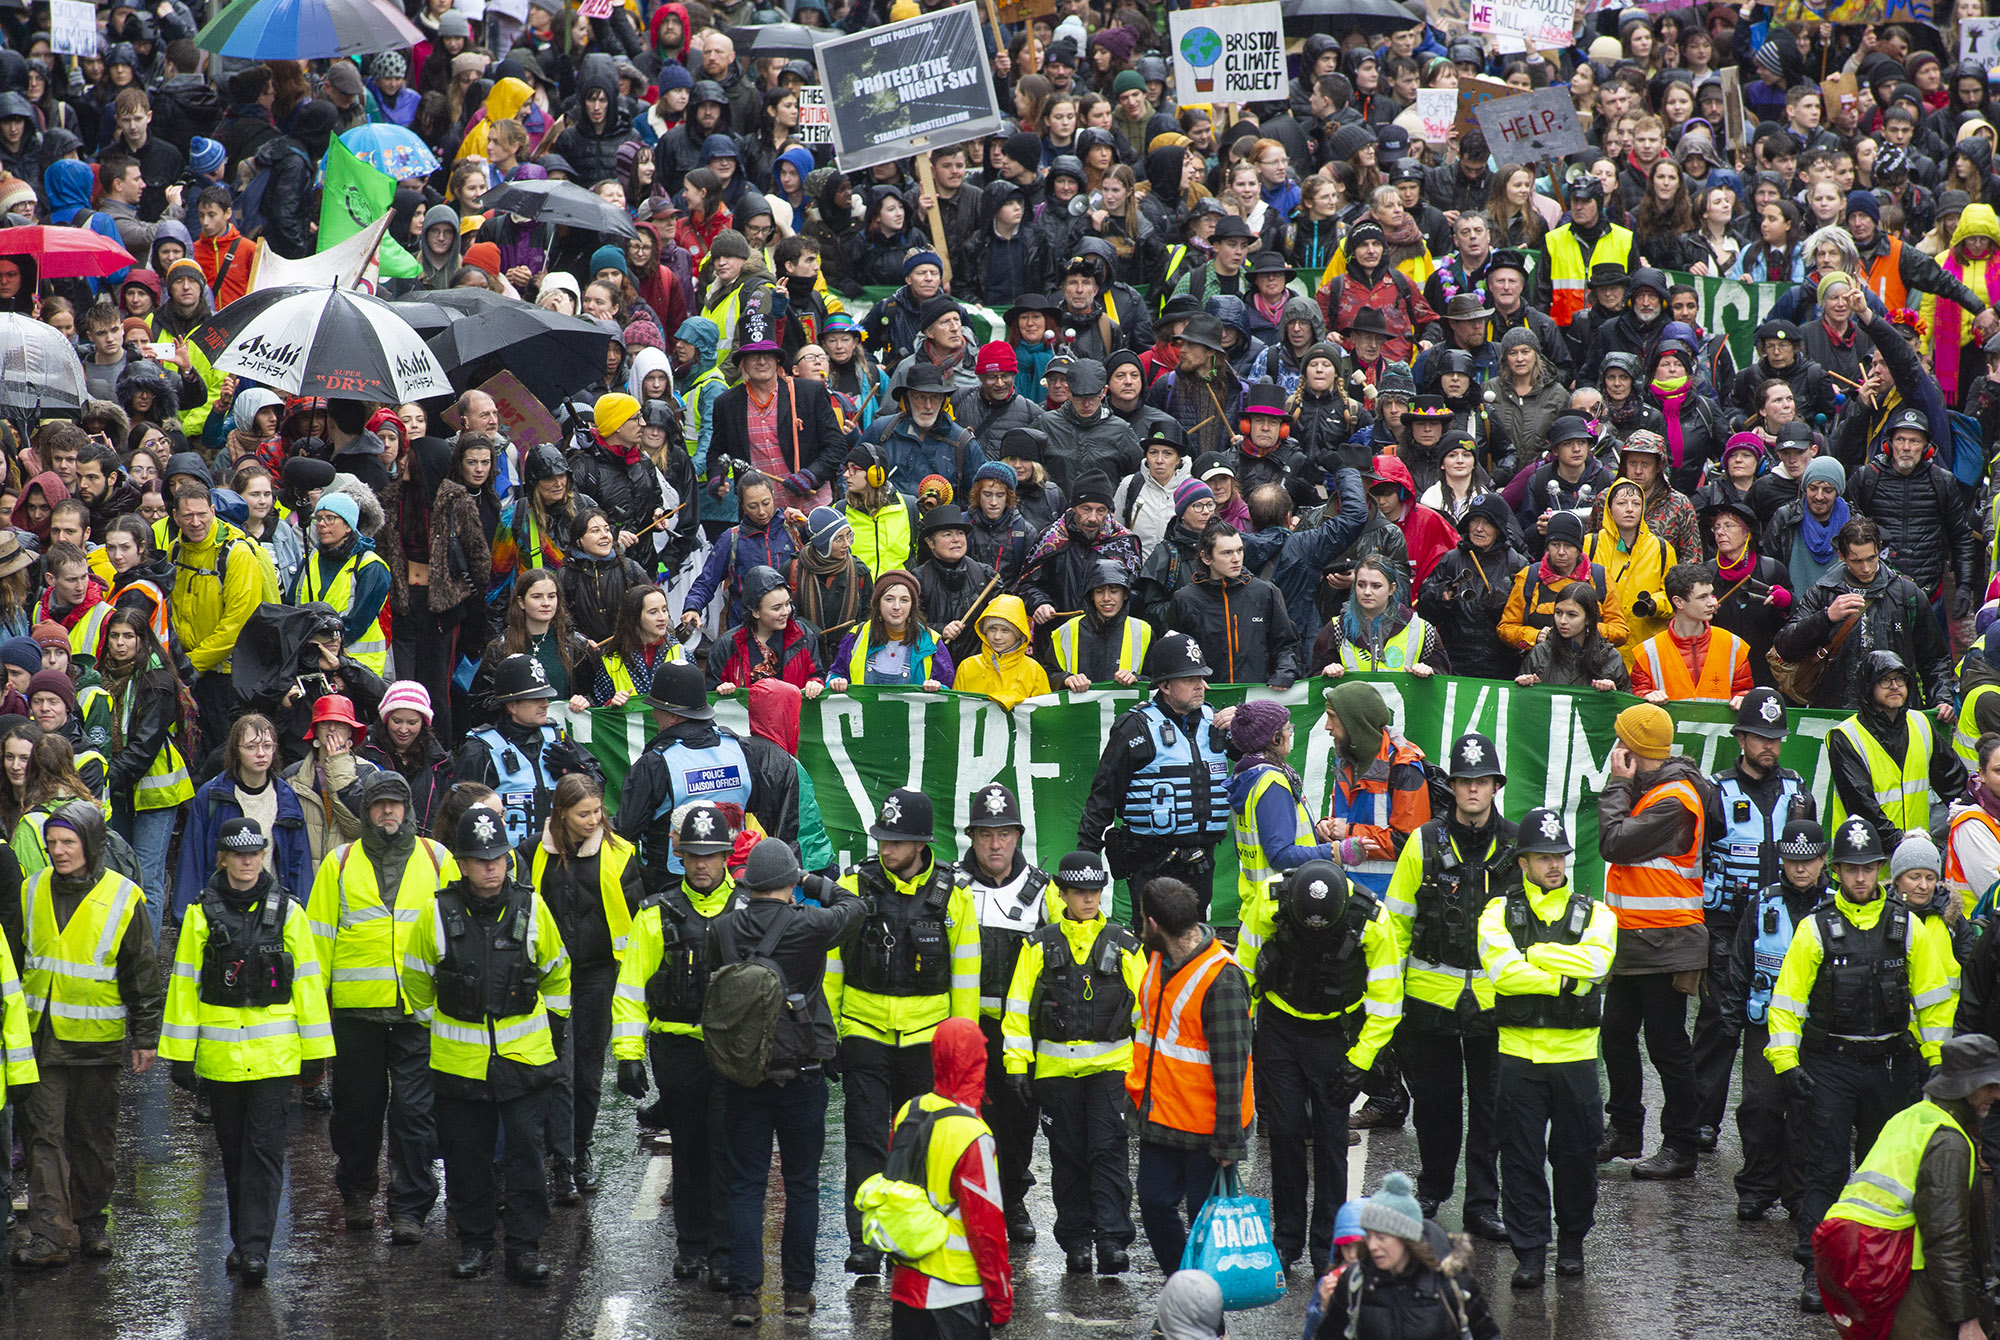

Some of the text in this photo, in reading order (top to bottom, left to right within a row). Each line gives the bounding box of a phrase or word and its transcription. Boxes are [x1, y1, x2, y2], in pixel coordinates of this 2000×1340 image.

[1472, 4, 1493, 24] WE
[1543, 15, 1570, 28] ACT
[870, 22, 934, 47] LIGHT POLLUTION
[1226, 31, 1280, 52] BRISTOL
[1225, 51, 1281, 72] CLIMATE
[852, 55, 951, 98] PROTECT THE
[898, 66, 978, 104] NIGHT-SKY
[1226, 72, 1282, 91] PROJECT
[873, 111, 970, 145] STARLINK CONSTELLATION
[1498, 110, 1562, 143] HELP.
[237, 333, 303, 367] Asahi
[237, 356, 288, 380] スーパードライ
[332, 369, 361, 377] SUPER
[395, 349, 431, 379] Asahi
[702, 768, 725, 781] POLICE
[688, 777, 740, 793] LIAISON OFFICER
[1438, 873, 1461, 884] POLICE
[916, 920, 940, 931] POLICE
[259, 943, 284, 954] POLICE
[1757, 956, 1781, 965] POLICE
[1884, 958, 1905, 969] POLICE
